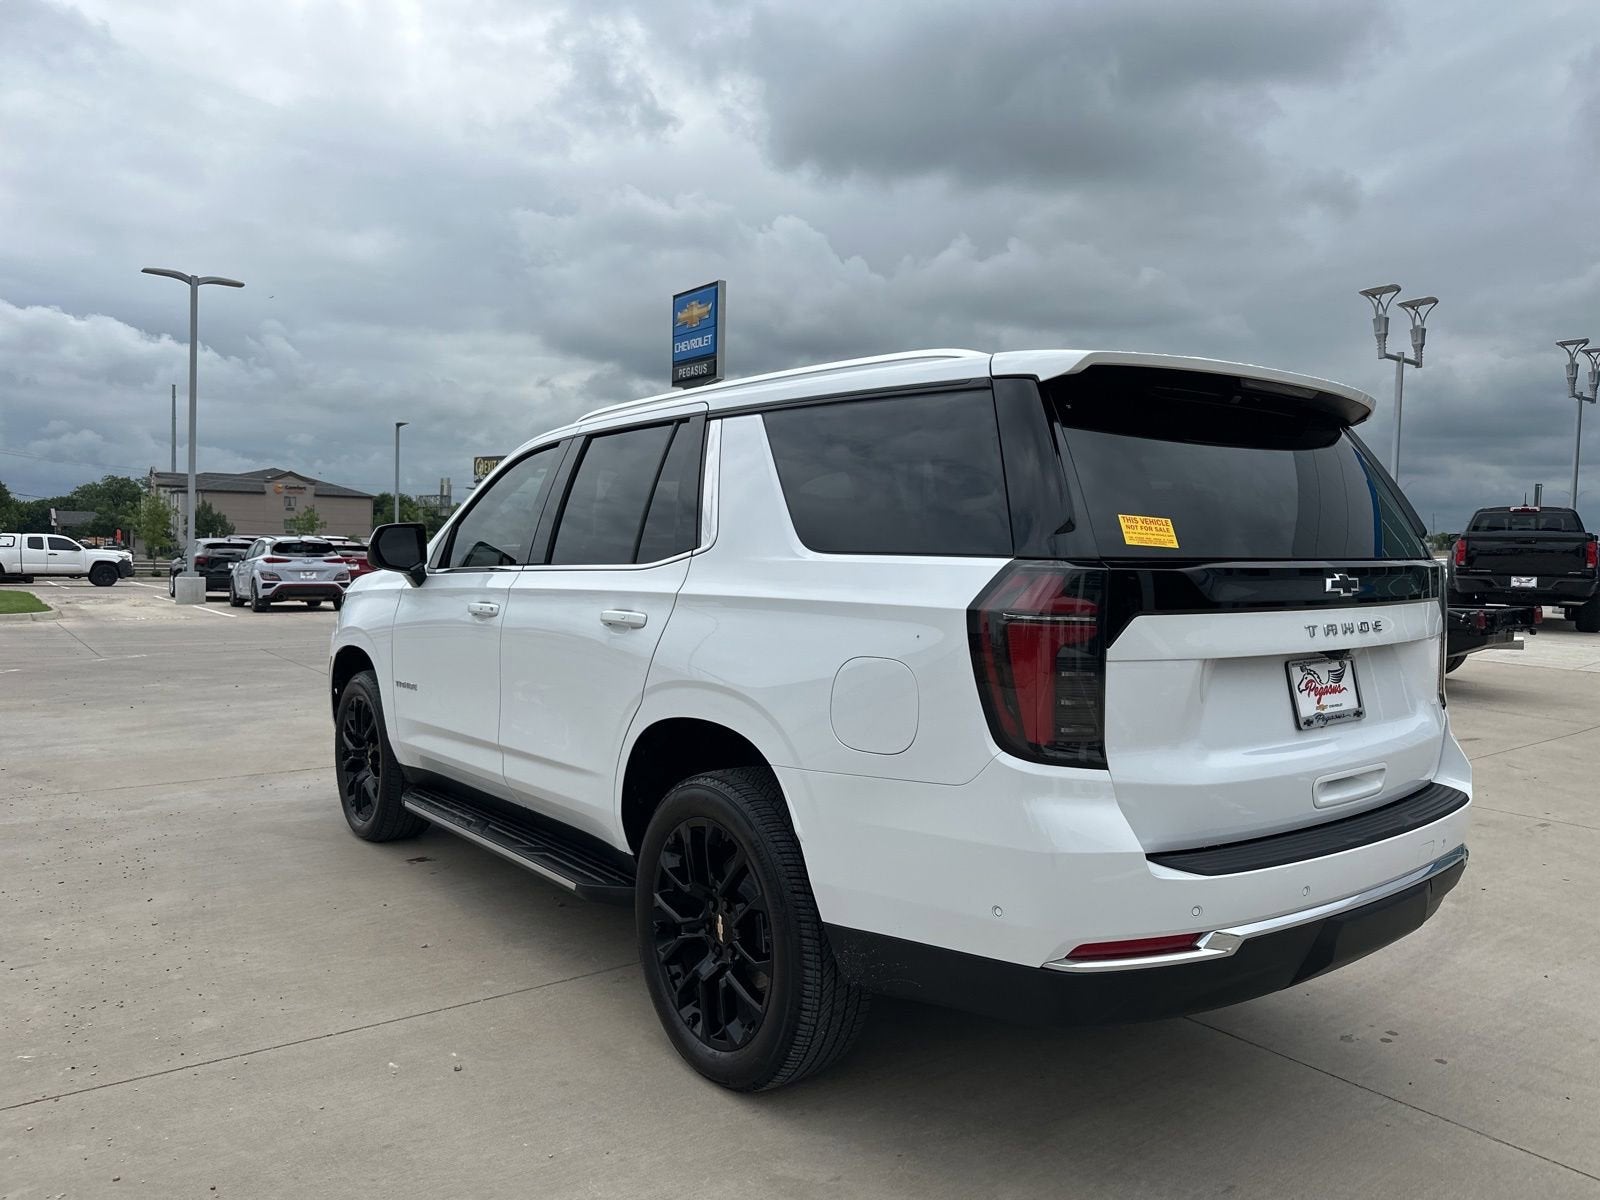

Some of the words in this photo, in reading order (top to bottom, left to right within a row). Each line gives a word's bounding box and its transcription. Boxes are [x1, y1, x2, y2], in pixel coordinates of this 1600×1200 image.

[674, 334, 712, 353] CHEVROLET
[678, 363, 708, 378] PEGASUS
[1122, 516, 1138, 525] THIS
[1140, 518, 1170, 527] VEHICLE
[1304, 620, 1383, 638] TAHOE
[1305, 679, 1347, 705] Pegasus
